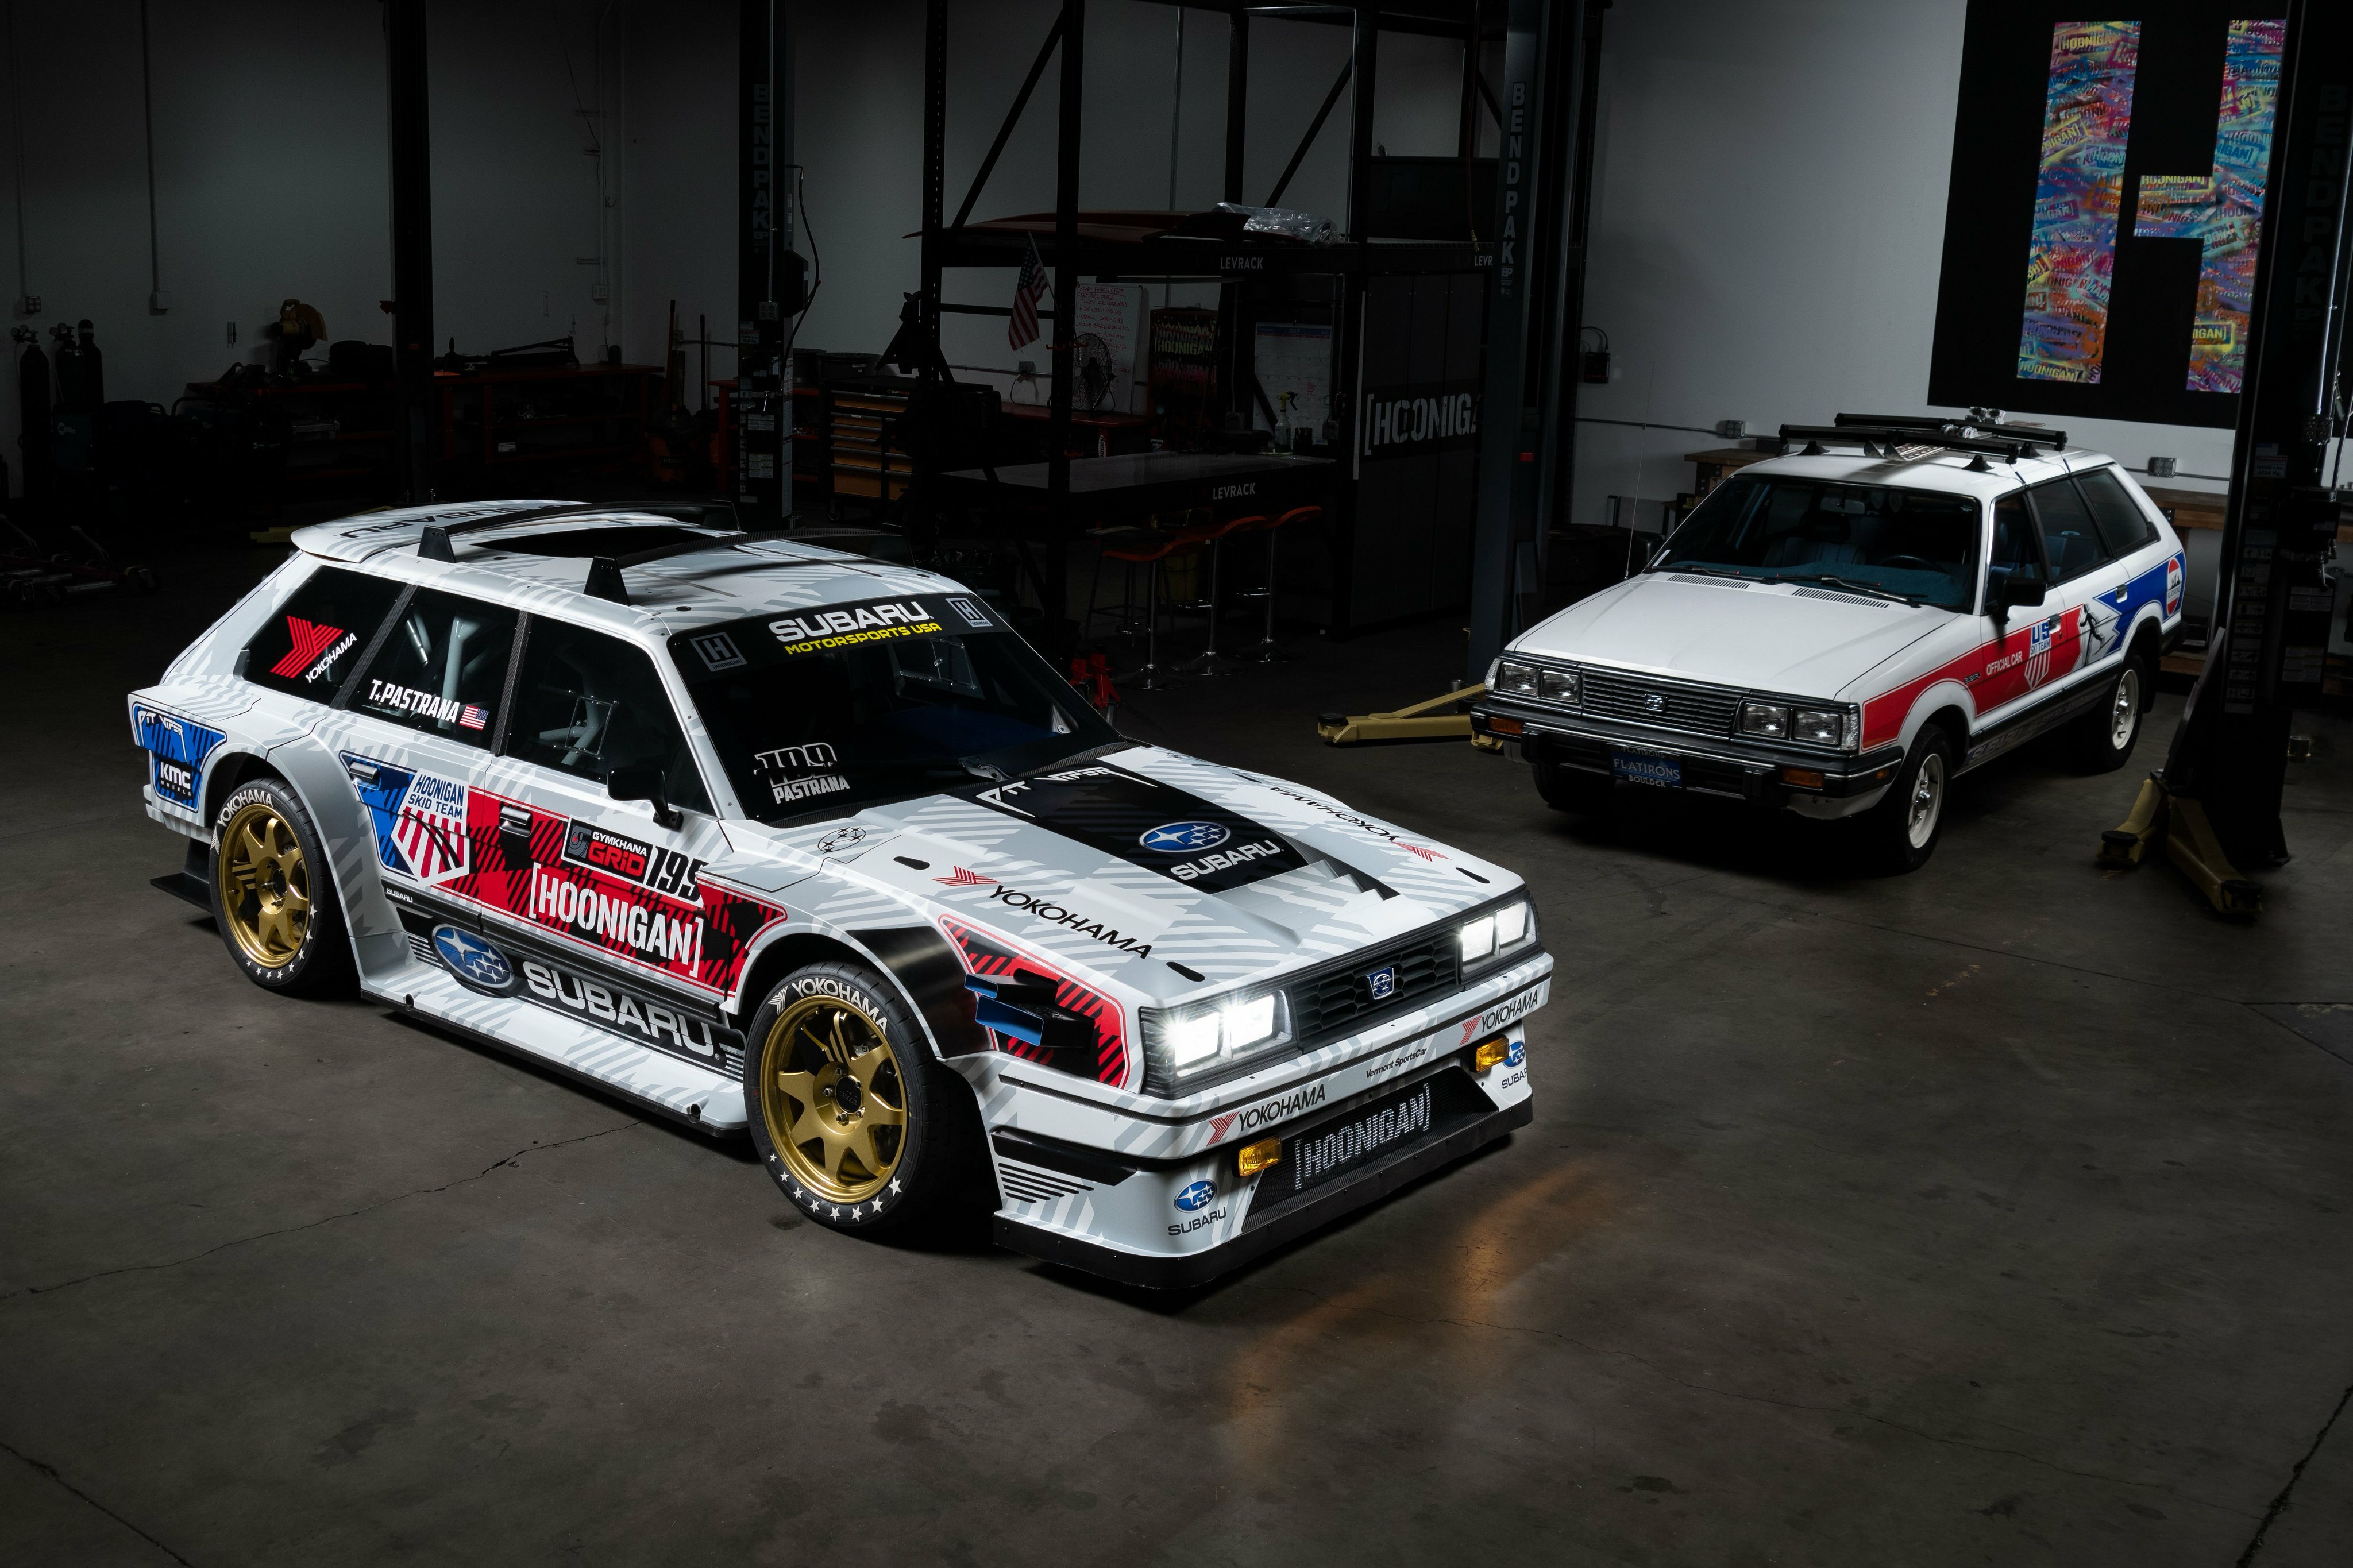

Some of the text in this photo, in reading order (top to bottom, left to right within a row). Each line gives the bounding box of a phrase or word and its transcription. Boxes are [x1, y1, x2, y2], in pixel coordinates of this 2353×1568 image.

[754, 84, 769, 229] BENDPAK
[1501, 82, 1526, 264] BENDPAK
[1220, 257, 1264, 269] LEVRACK
[1213, 482, 1256, 500] LEVRACK
[769, 601, 931, 642] SUBARU
[2032, 621, 2050, 644] US
[701, 637, 733, 661] H
[785, 622, 943, 655] MOTORSPORTS USA
[2038, 639, 2050, 651] TEAM
[304, 632, 358, 684] YOKOHAMA
[1986, 651, 2023, 677] OFFICIAL CAR
[1613, 758, 1681, 780] FLATIRONS
[1628, 775, 1667, 788] BOULDER
[160, 780, 192, 797] WHEELS
[412, 774, 465, 807] HOONIGAN
[772, 774, 851, 805] PASTRANA
[217, 789, 275, 828] YOKOHAMA
[407, 794, 463, 820] SKID TEAM
[1268, 786, 1401, 842] YOKOHAMA
[592, 831, 647, 857] GYMKHANA
[1170, 839, 1282, 881] SUBARU
[386, 887, 414, 903] SUBARU
[529, 862, 704, 979] [HOONIGAN]
[988, 884, 1154, 960] YOKOHAMA
[522, 961, 714, 1057] SUBARU
[791, 977, 888, 1036] YOKOHAMA
[1481, 988, 1539, 1034] YOKOHAMA
[1365, 1048, 1428, 1079] Vermont SportsCar
[1237, 1083, 1326, 1132] YOKOHAMA
[1294, 1082, 1431, 1191] [HOONIGAN]
[1167, 1206, 1227, 1236] SUBARU
